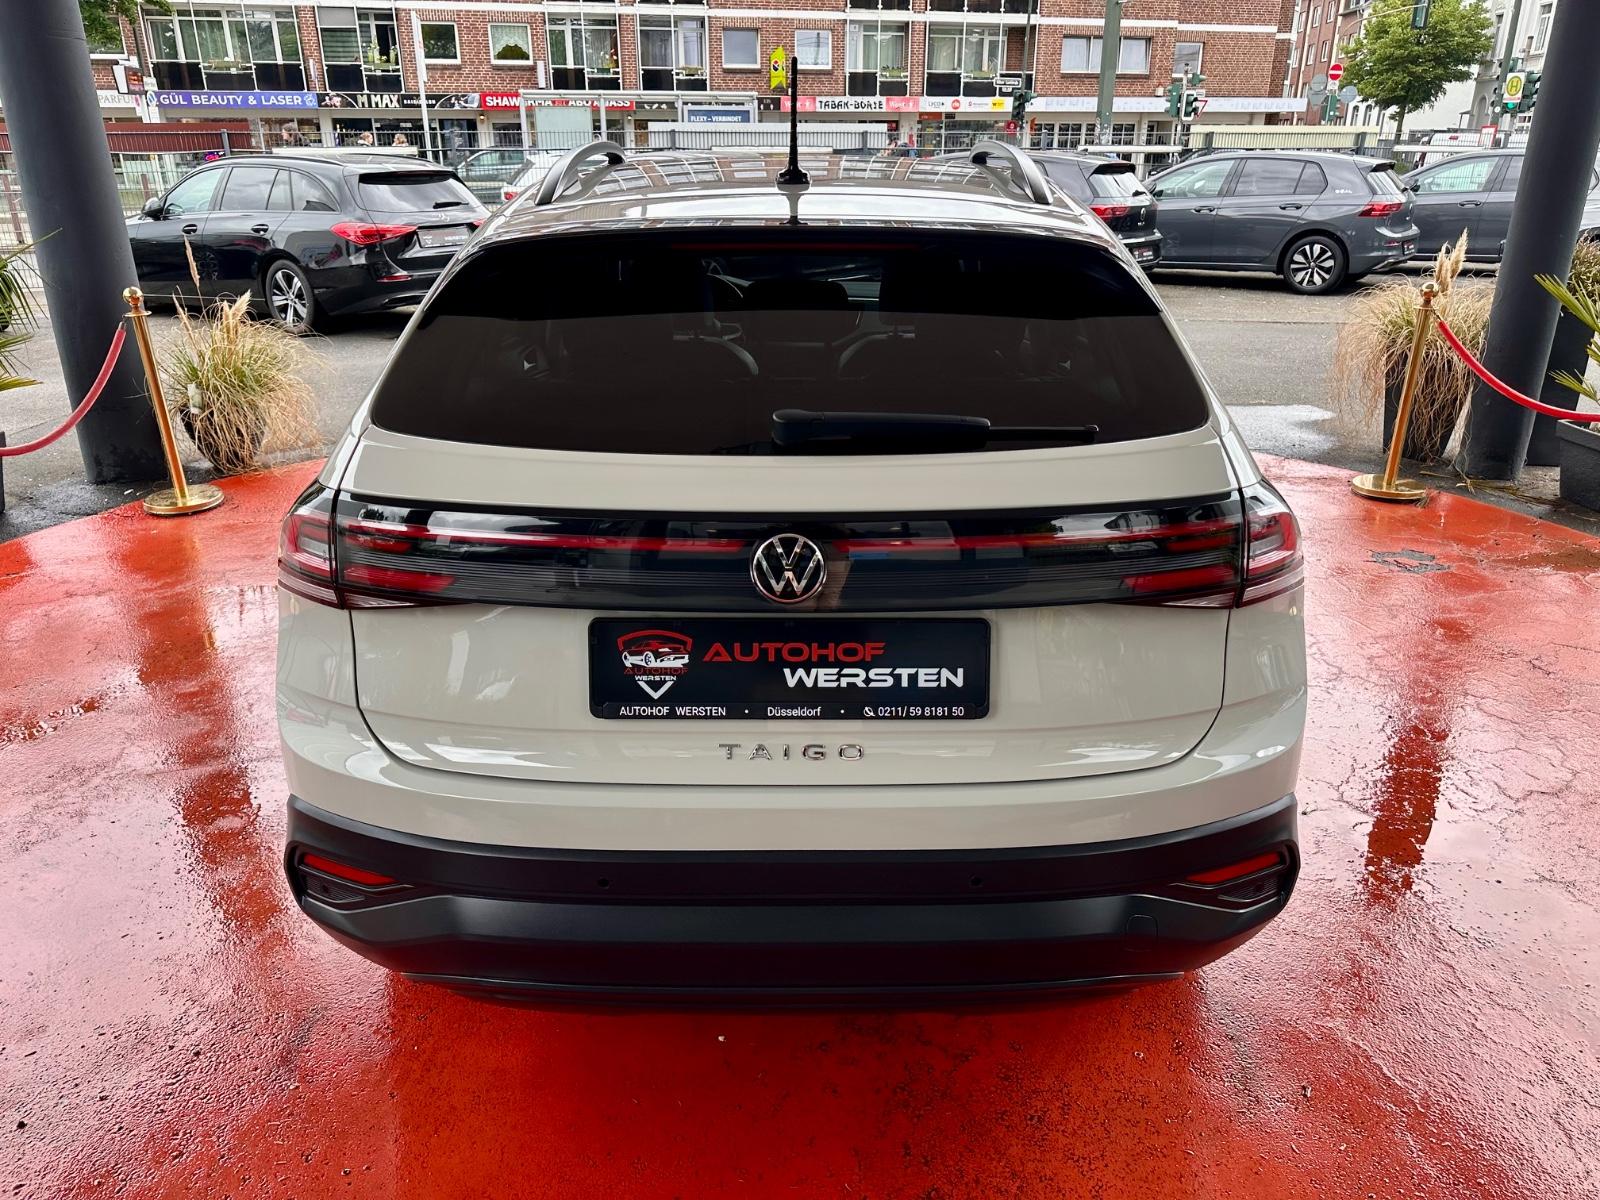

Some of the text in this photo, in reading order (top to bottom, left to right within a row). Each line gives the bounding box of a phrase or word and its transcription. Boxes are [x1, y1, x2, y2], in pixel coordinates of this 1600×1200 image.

[192, 95, 243, 105] BEAUTY
[248, 95, 257, 105] &
[261, 95, 302, 105] LASER
[371, 94, 400, 108] MAX
[703, 642, 886, 662] AUTOHOF
[624, 667, 688, 675] AUTOHOF
[783, 667, 964, 688] WERSTEN
[619, 705, 965, 717] AUTOHOF WERSTEN Düsseldorf 0211/ 59 8181 50
[718, 743, 865, 761] TAIGO
